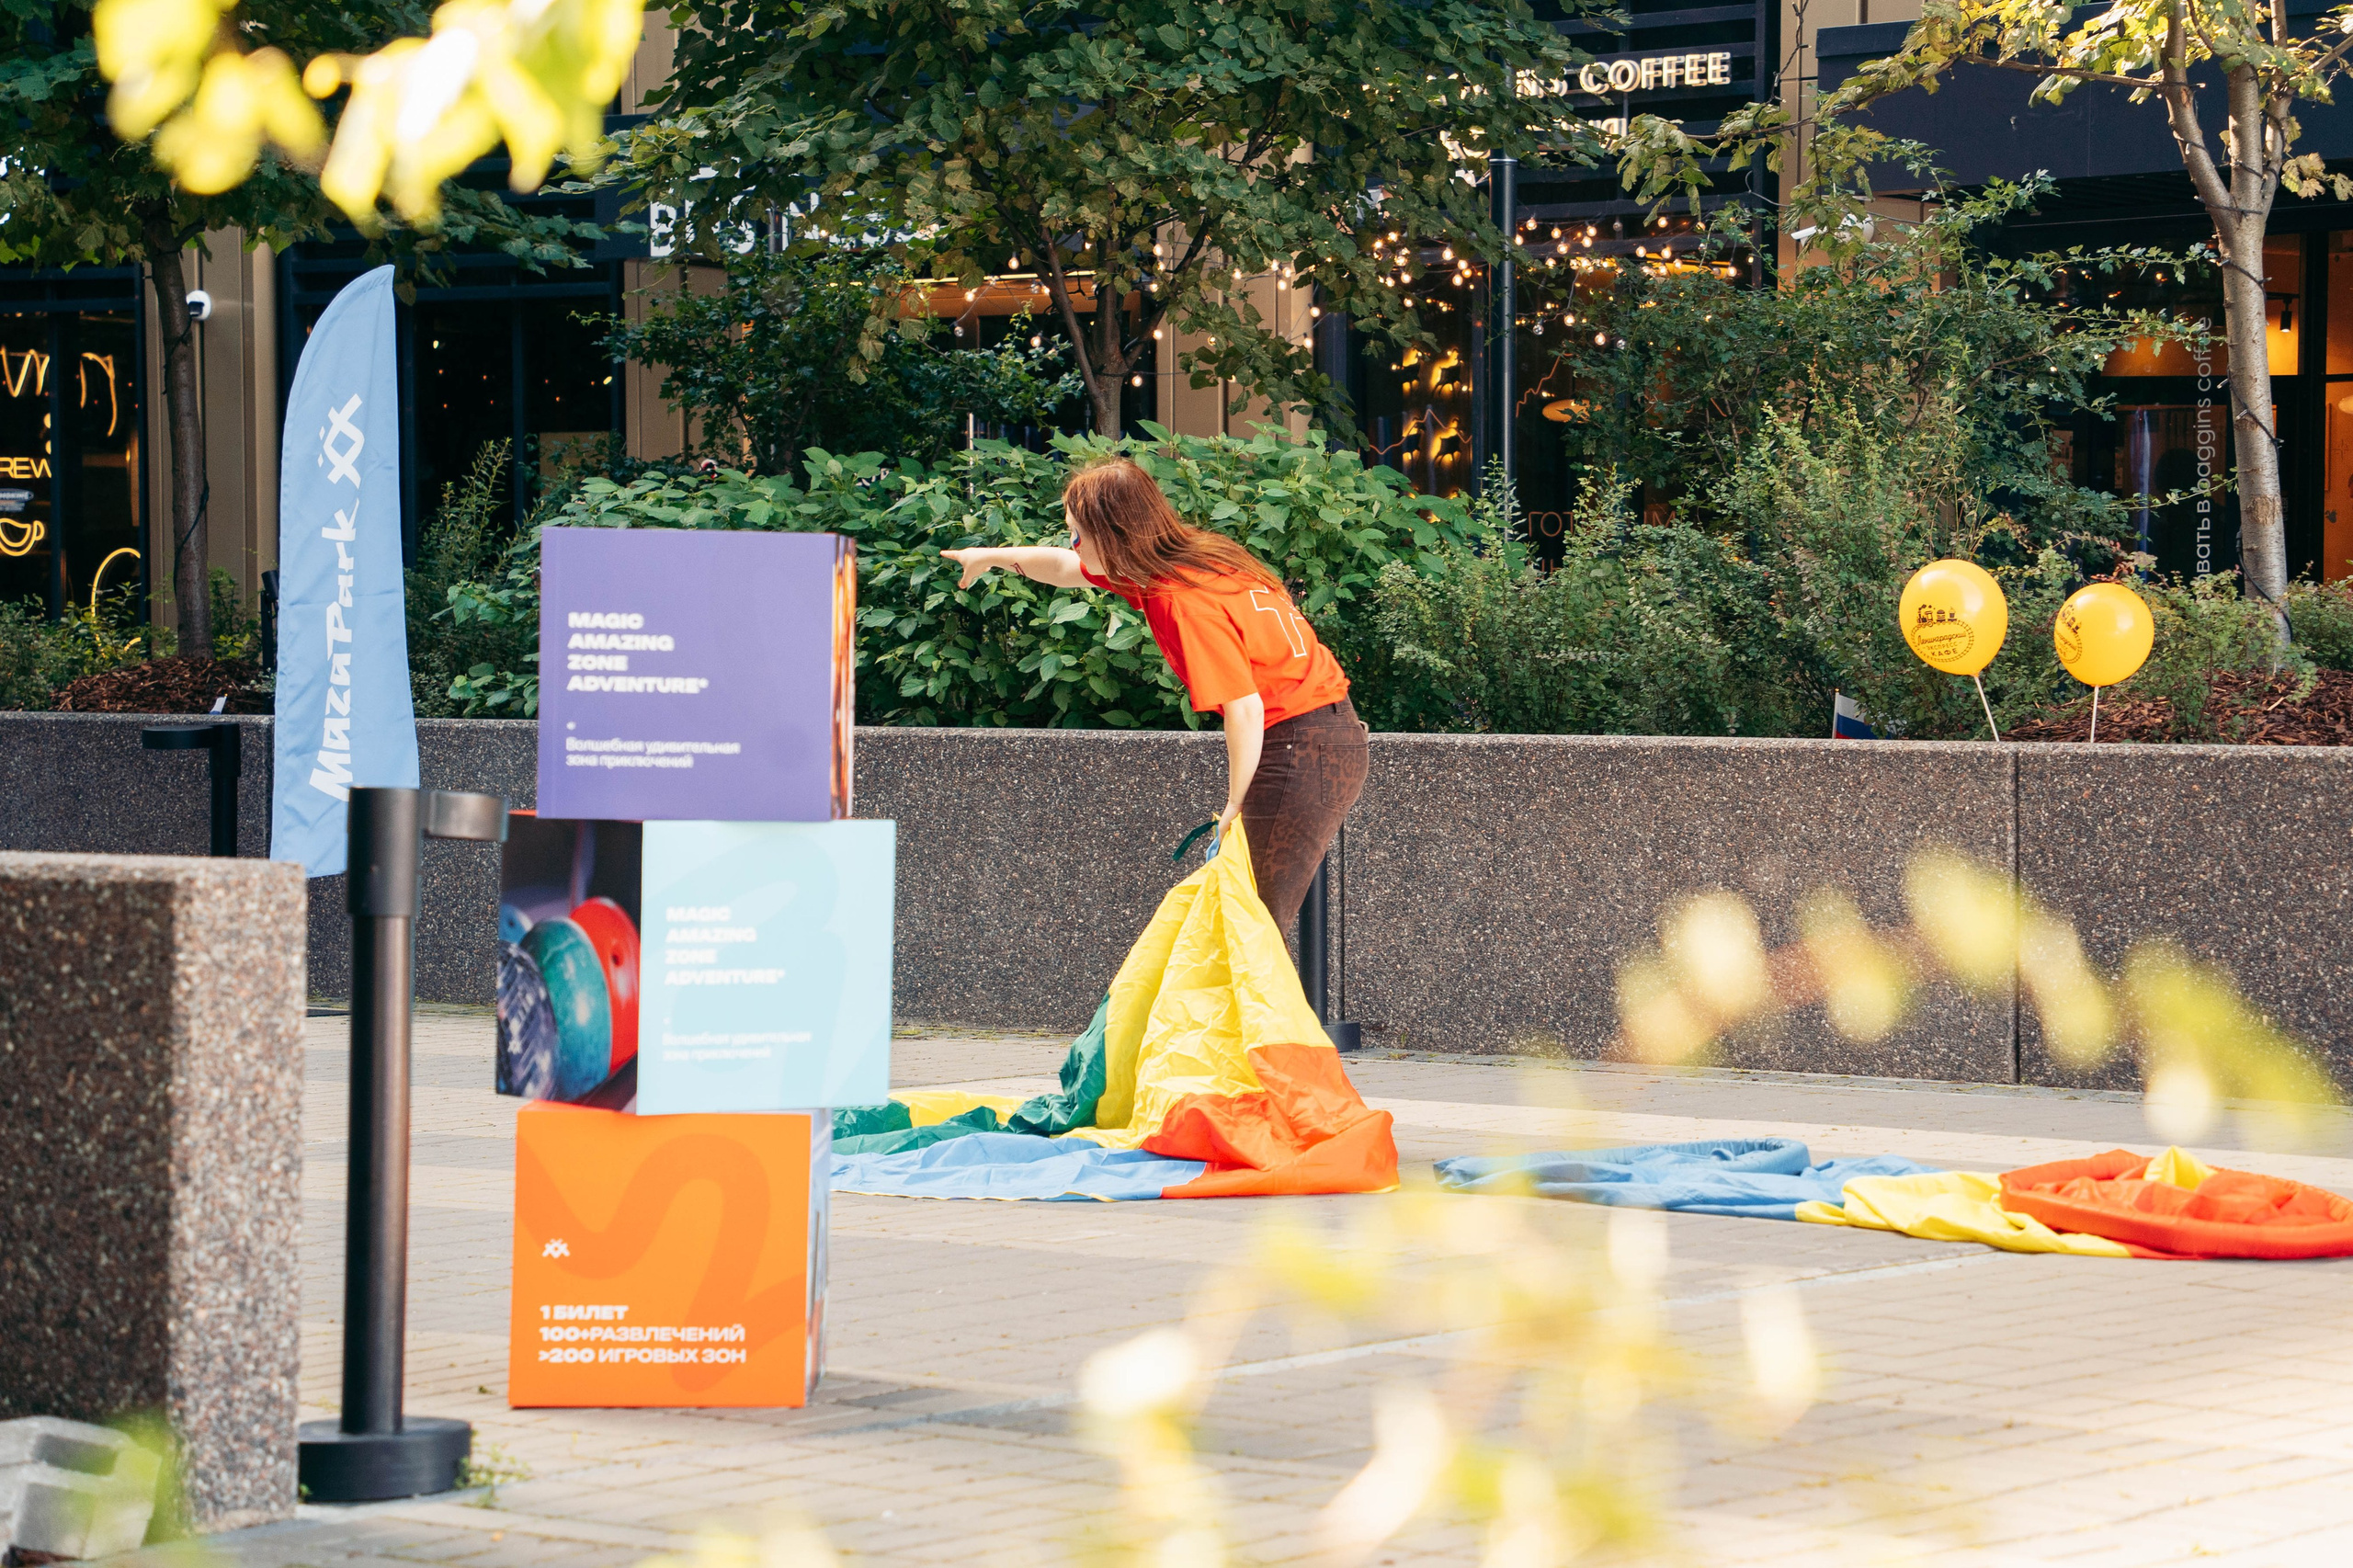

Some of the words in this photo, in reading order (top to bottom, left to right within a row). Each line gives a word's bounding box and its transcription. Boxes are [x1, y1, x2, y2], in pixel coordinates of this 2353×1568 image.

[1579, 51, 1732, 93] COFFEE
[2193, 316, 2211, 392] coffee
[567, 611, 644, 630] MAGIC
[309, 497, 360, 802] MazaPark
[567, 632, 676, 652] AMAZING
[1932, 648, 1958, 656] КАФЕ
[566, 653, 629, 672] ZONE
[566, 737, 643, 752] Волшебная
[644, 741, 741, 756] удивительная
[565, 755, 598, 767] зона
[599, 754, 694, 770] приключений
[666, 907, 731, 921] MAGIC
[665, 927, 757, 942] AMAZING
[665, 949, 717, 964] ZONE
[552, 1304, 630, 1321] БИЛЕТ
[597, 1347, 699, 1364] ИГРОВЫХ
[700, 1347, 746, 1364] ЗОН
